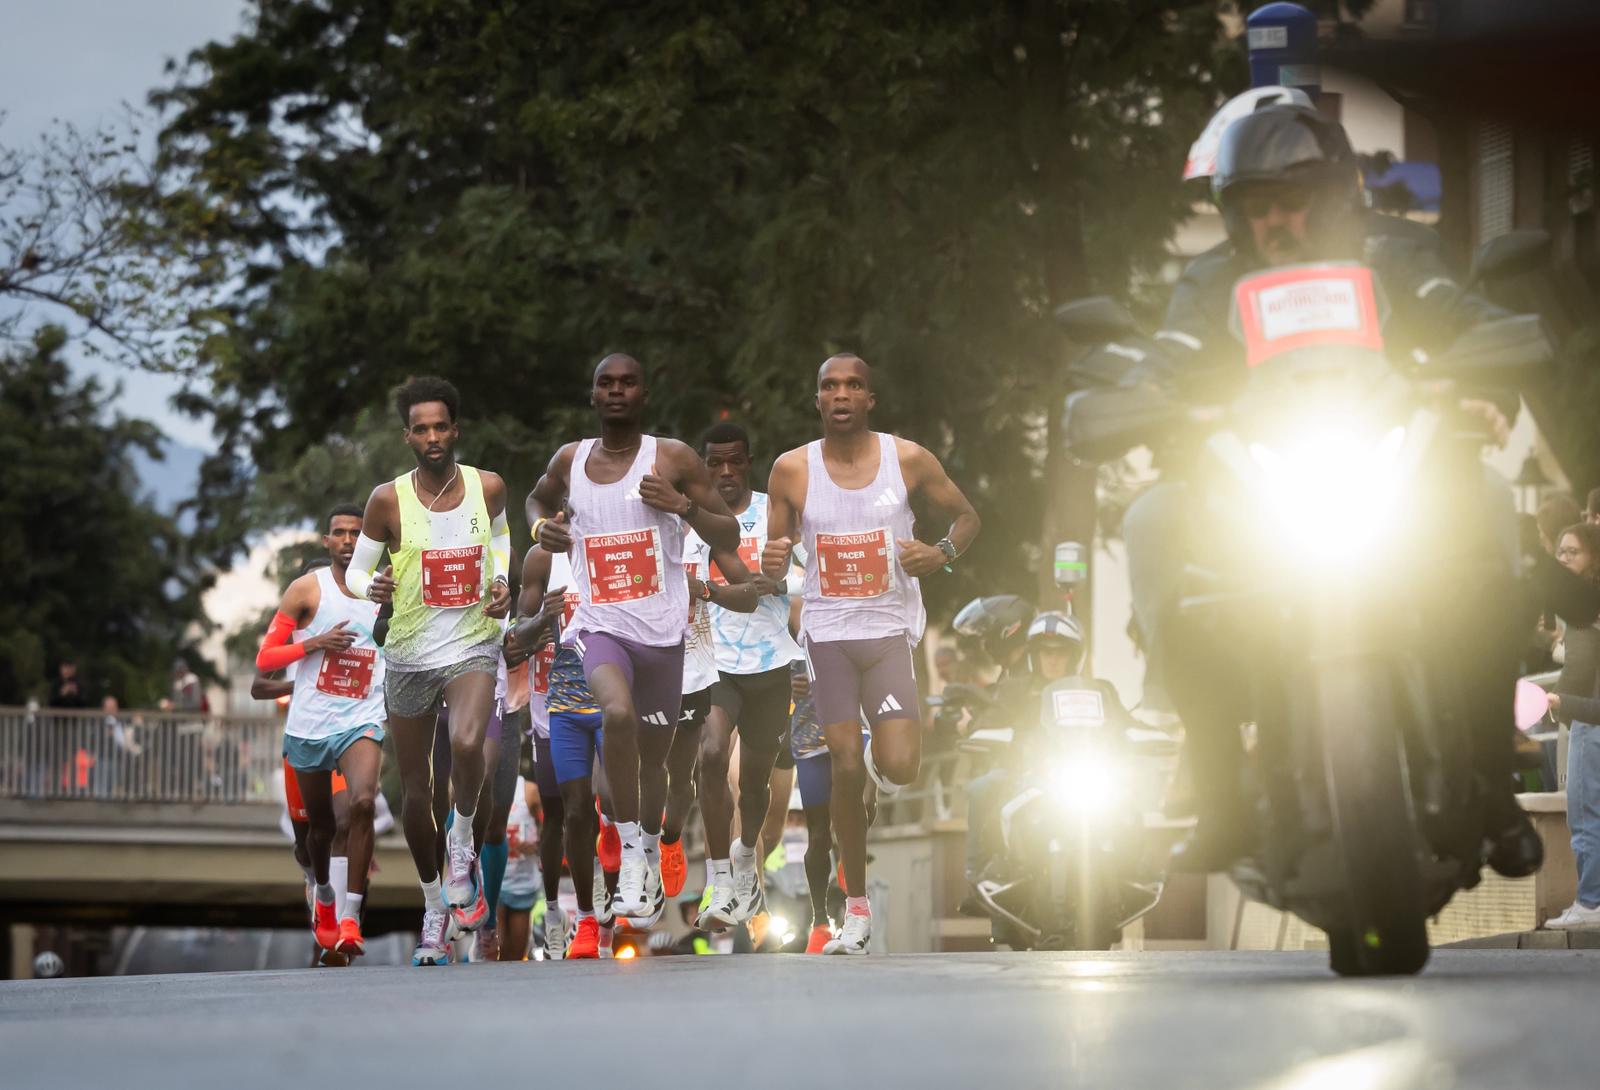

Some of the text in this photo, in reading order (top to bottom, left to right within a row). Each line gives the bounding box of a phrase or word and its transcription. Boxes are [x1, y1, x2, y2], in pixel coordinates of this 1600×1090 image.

[600, 532, 648, 547] GENERALI
[832, 531, 880, 545] GENERALI
[439, 547, 479, 559] GENERALI
[605, 551, 633, 562] PACER
[837, 550, 865, 560] PACER
[443, 563, 465, 572] ZEREI
[614, 564, 627, 574] 22
[846, 563, 857, 572] 21
[451, 575, 457, 583] 1
[338, 658, 361, 668] ENYEW
